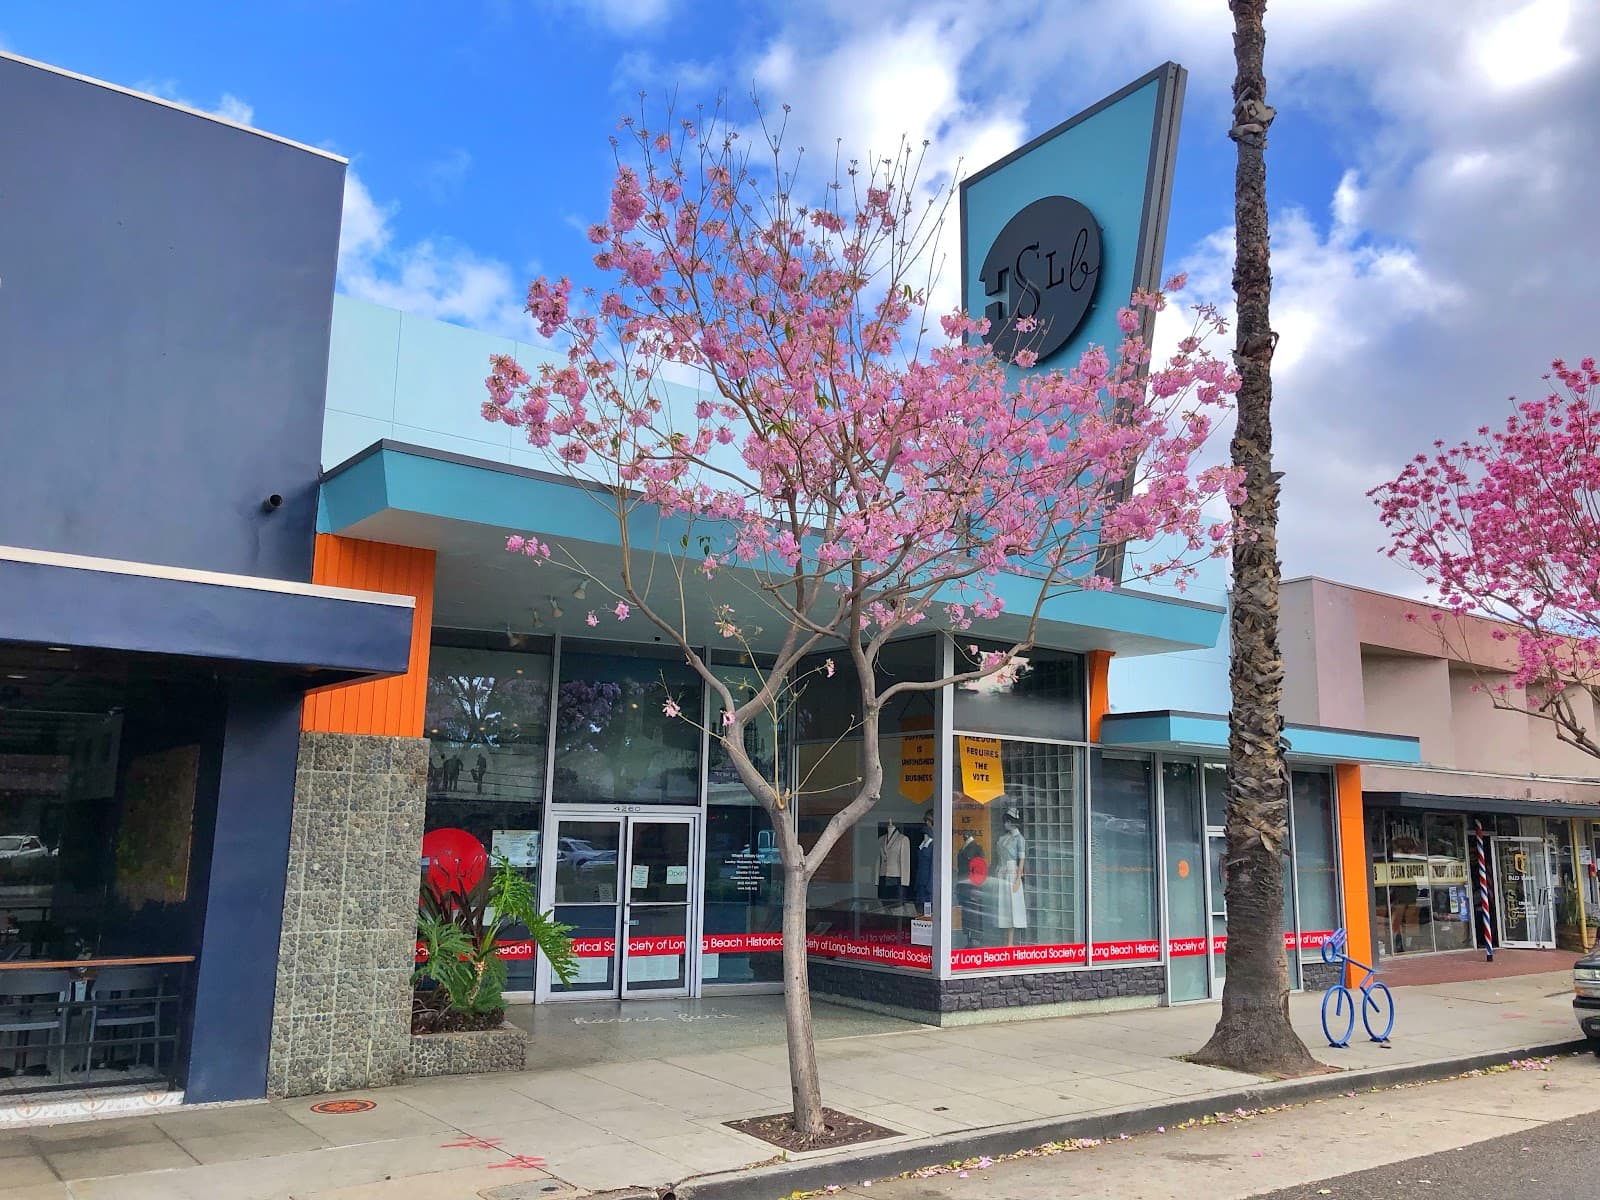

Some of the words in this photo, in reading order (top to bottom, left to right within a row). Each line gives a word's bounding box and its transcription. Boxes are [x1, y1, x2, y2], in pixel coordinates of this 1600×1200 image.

[966, 746, 999, 759] REQUIRES
[974, 761, 988, 771] THE
[905, 774, 933, 782] BUSINESS
[972, 772, 990, 782] VOTE
[656, 939, 668, 950] of
[710, 937, 743, 949] Beach
[1174, 940, 1197, 953] Society
[1198, 939, 1205, 950] of
[820, 940, 829, 951] of
[829, 941, 846, 955] Long
[847, 943, 870, 956] Beach
[872, 944, 905, 960] Historical
[906, 950, 933, 965] Societ
[951, 953, 960, 965] of
[960, 952, 982, 966] Long
[983, 950, 1010, 963] Beach
[1012, 947, 1047, 961] Historical
[1048, 946, 1076, 960] Society
[1077, 946, 1086, 957] of
[1090, 946, 1109, 958] Long
[1110, 944, 1133, 955] Beach
